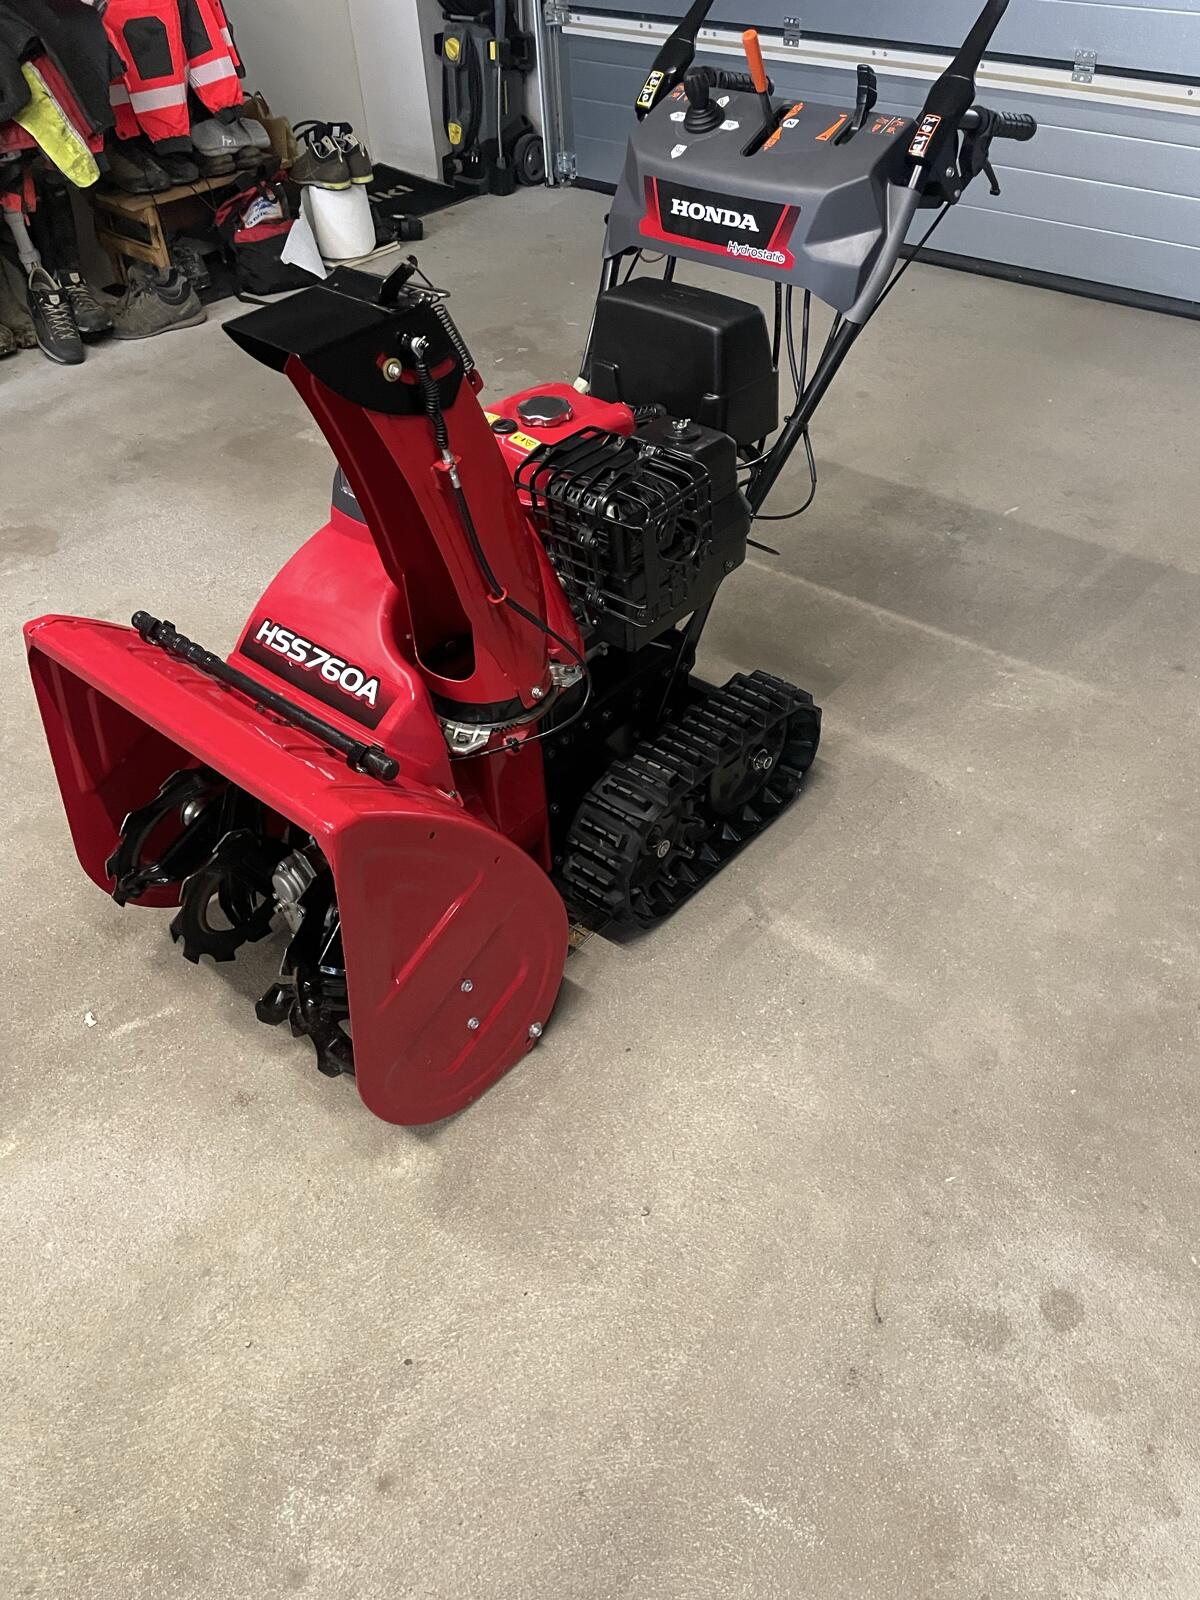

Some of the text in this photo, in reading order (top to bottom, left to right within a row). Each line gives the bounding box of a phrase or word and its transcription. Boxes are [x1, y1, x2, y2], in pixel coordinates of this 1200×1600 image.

[671, 199, 759, 232] HONDA
[727, 241, 785, 264] Hydrostatic
[255, 620, 378, 705] HSS760A
